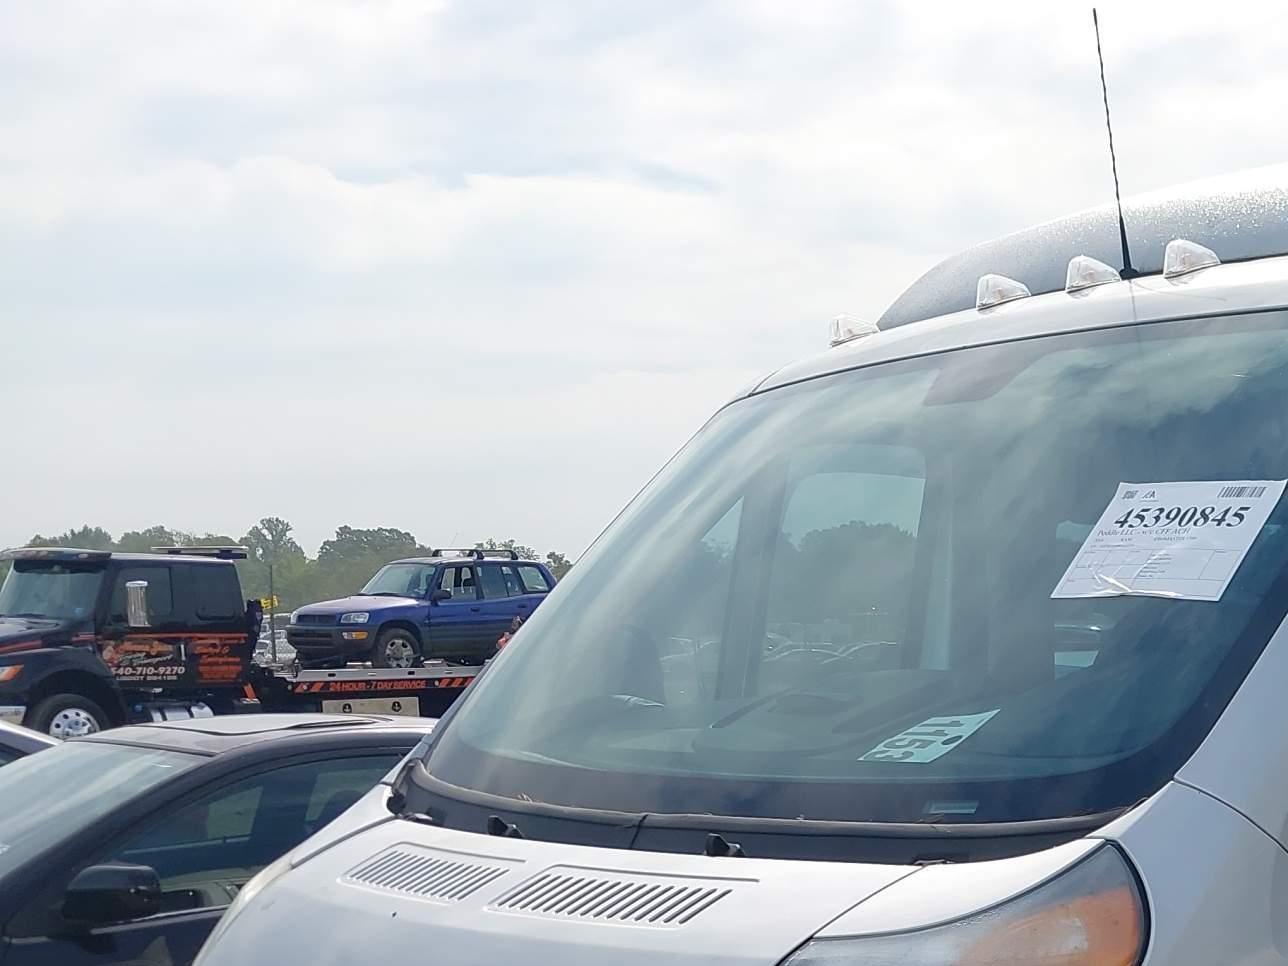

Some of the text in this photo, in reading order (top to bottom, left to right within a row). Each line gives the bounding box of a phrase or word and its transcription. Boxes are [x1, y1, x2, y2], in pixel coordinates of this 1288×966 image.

[1114, 506, 1251, 528] 45390845
[111, 666, 186, 675] 540-710-9270
[329, 682, 341, 691] 24
[342, 682, 366, 691] HOUR
[371, 681, 376, 689] 7
[377, 681, 393, 690] DAY
[393, 679, 426, 689] SERVICE
[863, 720, 967, 761] 1153
